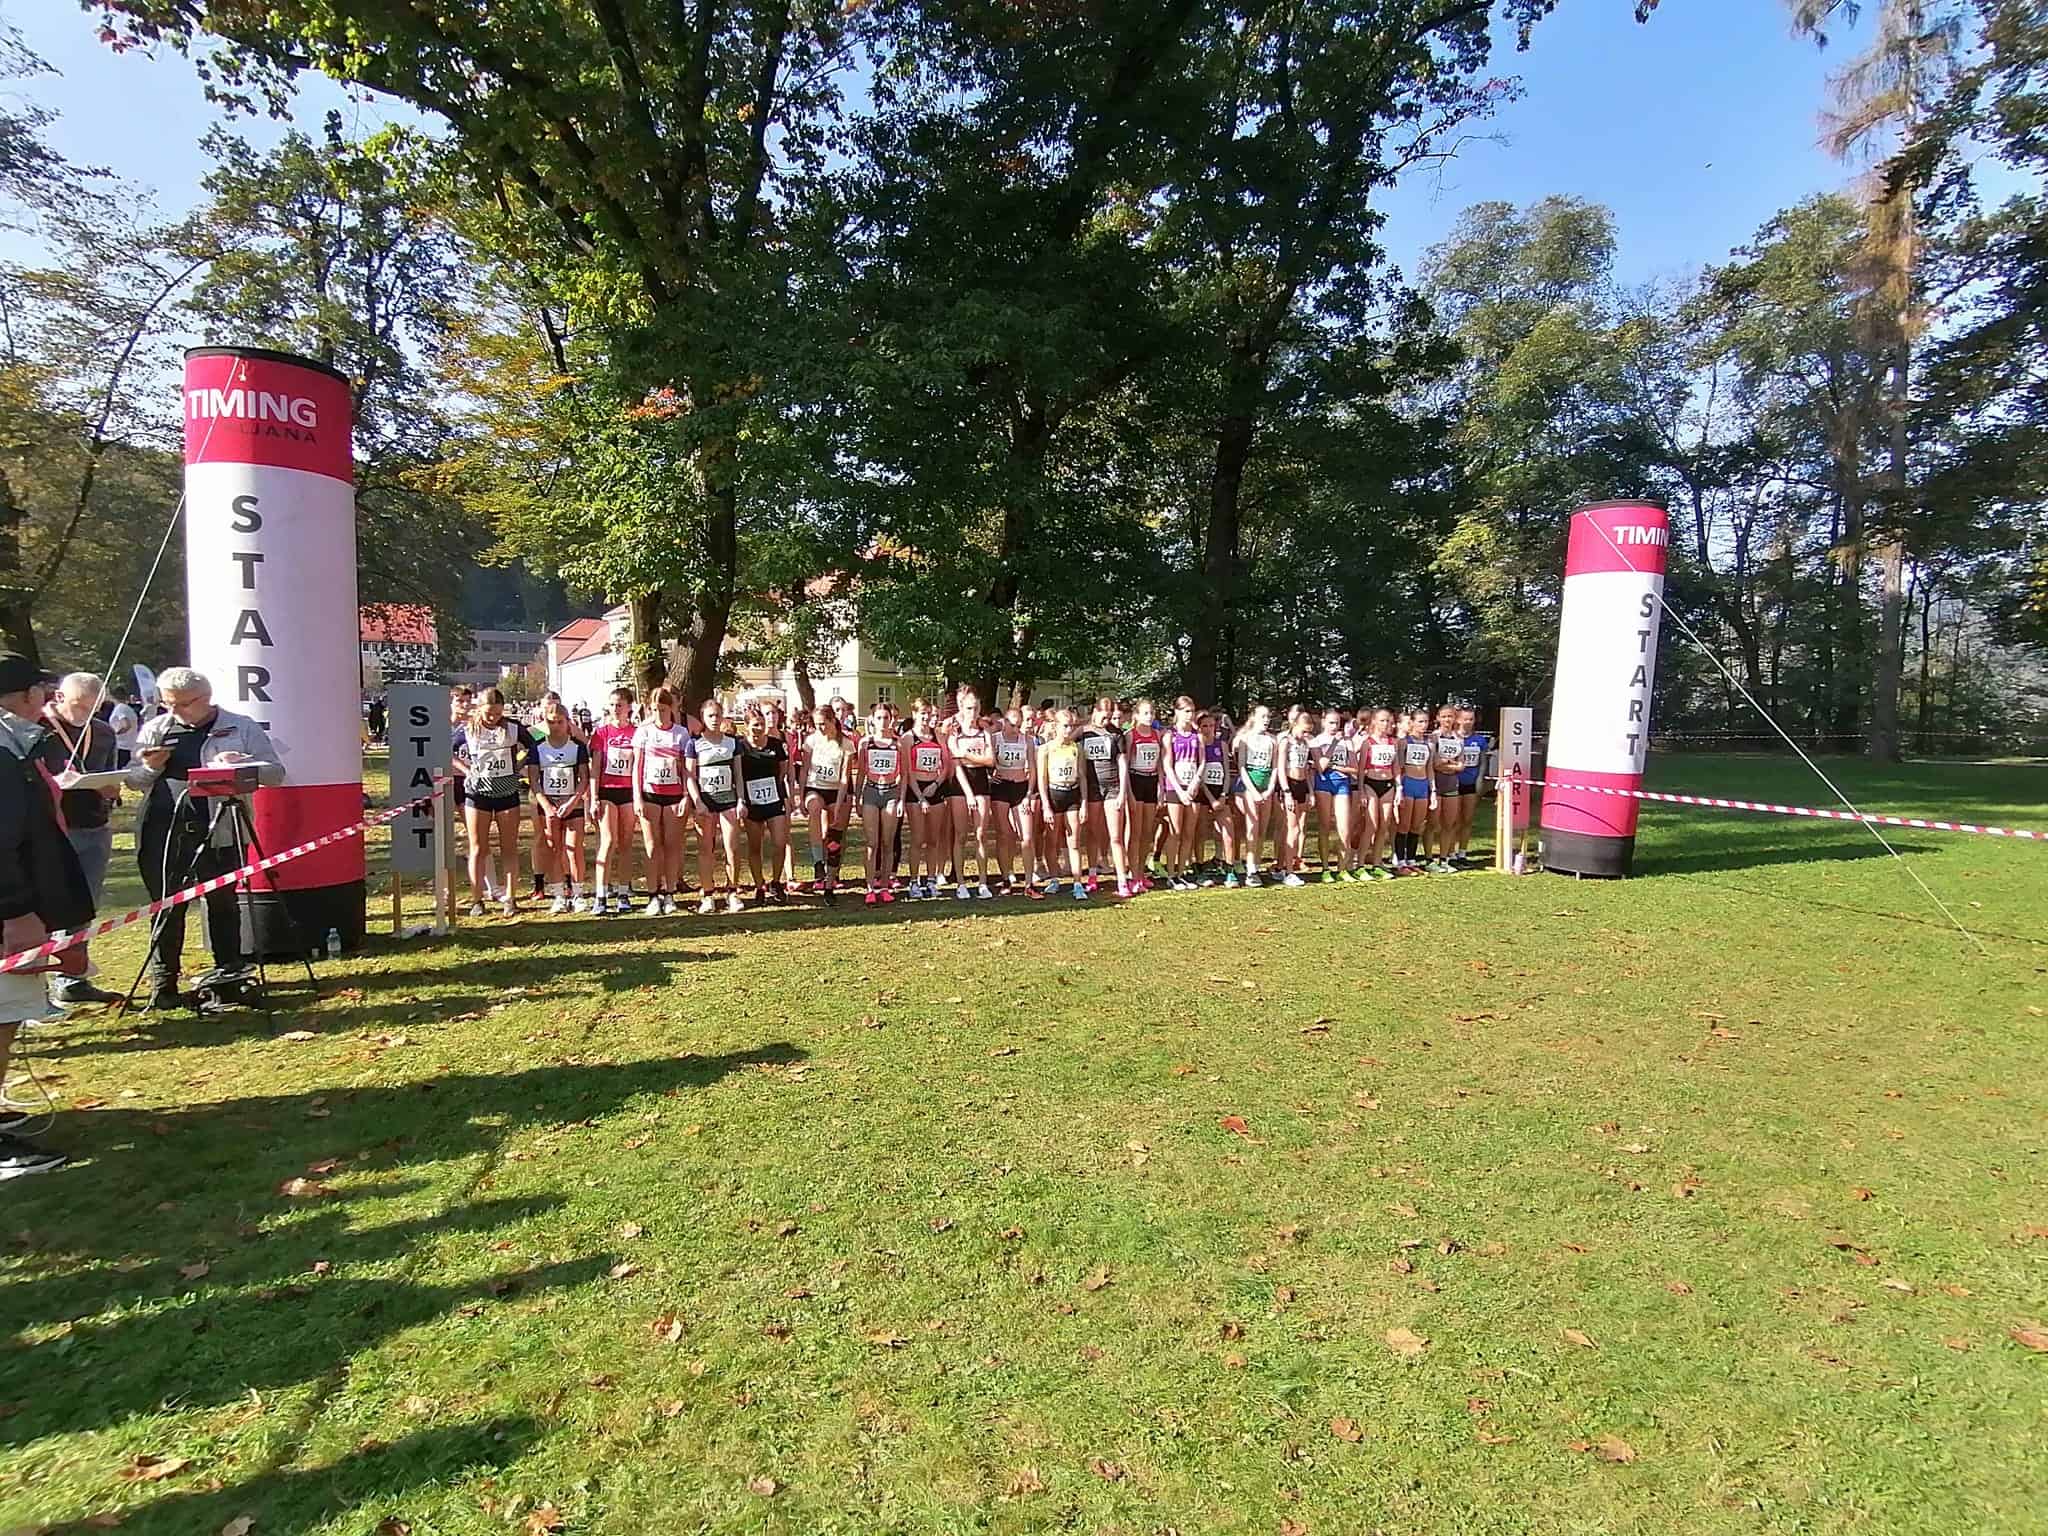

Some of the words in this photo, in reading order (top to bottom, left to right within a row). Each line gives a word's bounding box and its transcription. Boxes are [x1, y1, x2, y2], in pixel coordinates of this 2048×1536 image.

[188, 388, 318, 428] TIMING
[1625, 592, 1655, 756] START
[487, 759, 506, 771] 240
[612, 759, 629, 769] 201
[874, 759, 891, 769] 238
[1511, 721, 1524, 816] START
[408, 705, 435, 849] START
[654, 768, 671, 779] 202
[816, 766, 833, 777] 216
[1207, 770, 1221, 779] 222
[549, 778, 567, 788] 239
[708, 775, 726, 786] 241
